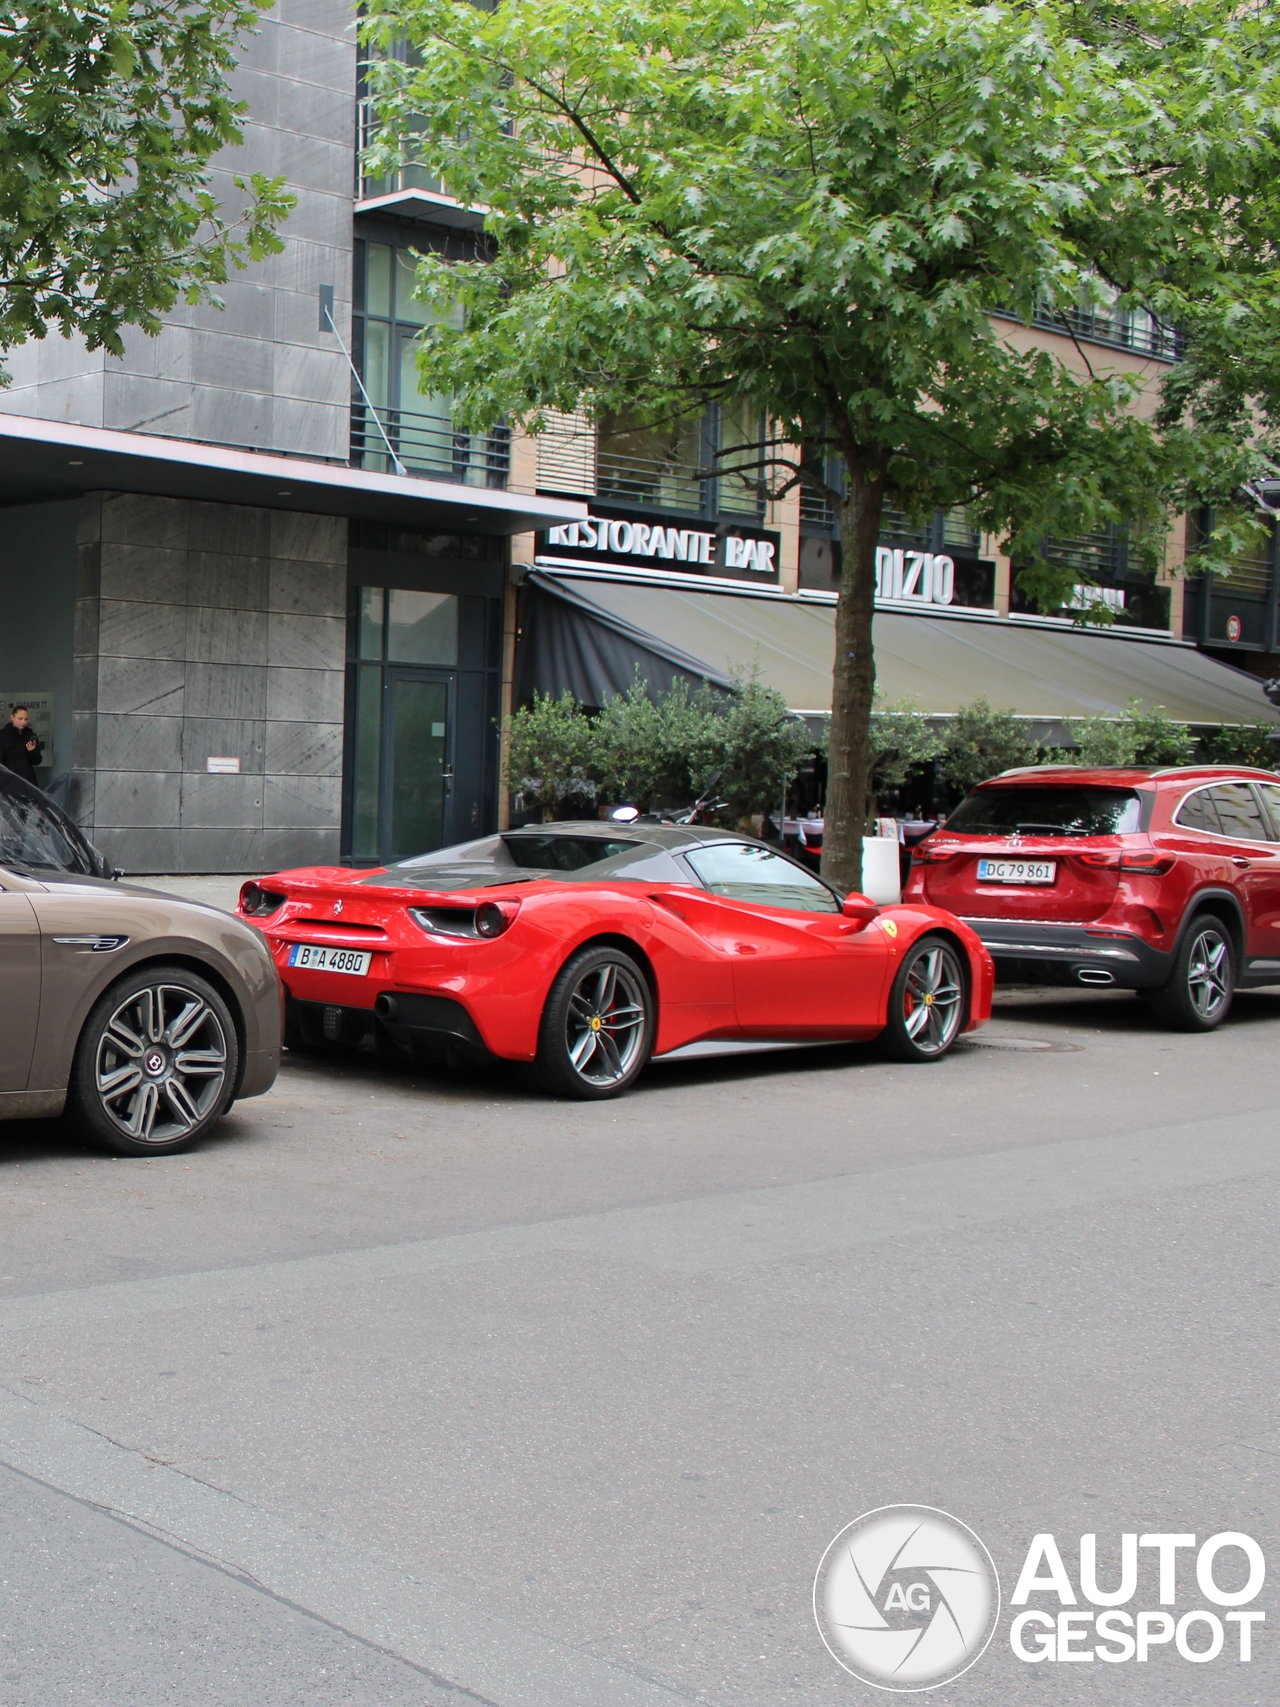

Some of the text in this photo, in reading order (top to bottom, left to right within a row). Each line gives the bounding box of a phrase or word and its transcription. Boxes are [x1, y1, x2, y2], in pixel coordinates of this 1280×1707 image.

[549, 516, 775, 572] RISTORANTE BAR
[875, 546, 954, 605] NIZIO
[986, 863, 1005, 877] DG
[1009, 864, 1025, 878] 79
[1027, 864, 1050, 878] 861
[300, 948, 364, 972] B A 4880
